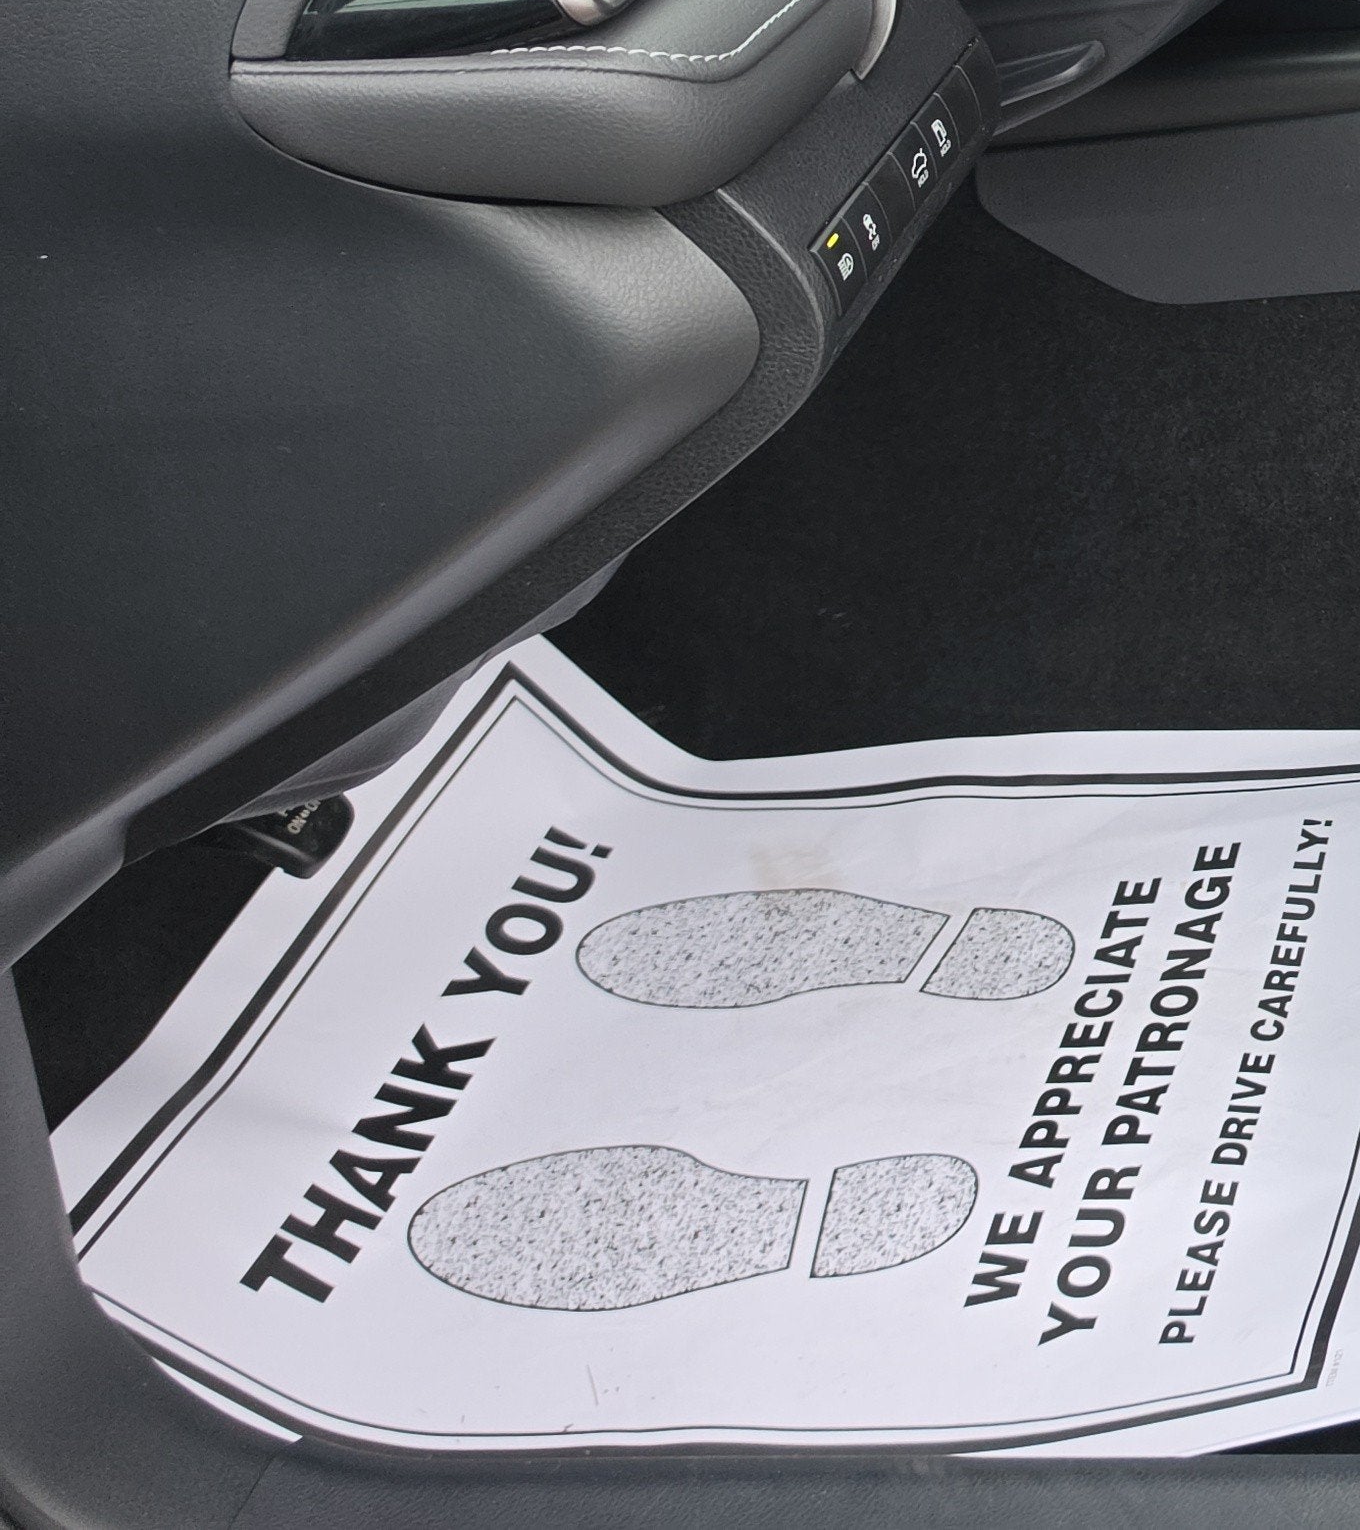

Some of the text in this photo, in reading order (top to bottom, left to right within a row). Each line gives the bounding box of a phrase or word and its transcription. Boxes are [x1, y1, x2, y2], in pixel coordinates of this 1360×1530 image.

[240, 828, 614, 1303] THANK YOU!
[965, 878, 1161, 1306] WE APPRECIATE
[1039, 843, 1241, 1345] YOUR PATRONAGE
[1159, 820, 1332, 1343] PLEASE DRIVE CAREFULLY!
